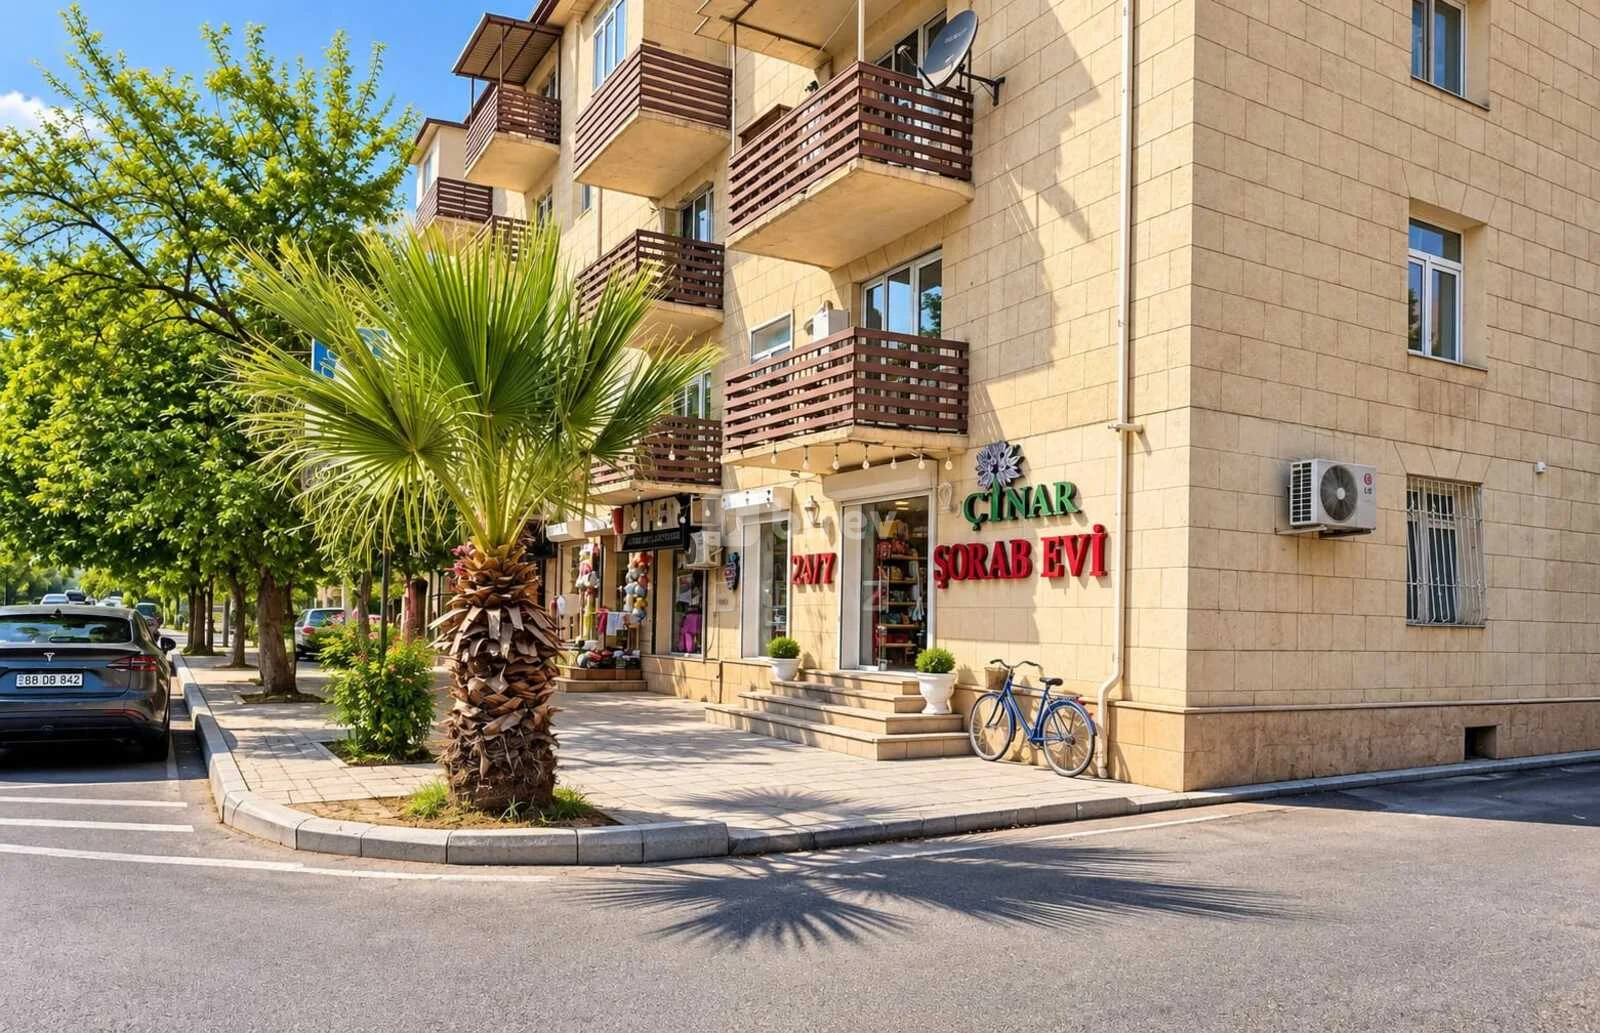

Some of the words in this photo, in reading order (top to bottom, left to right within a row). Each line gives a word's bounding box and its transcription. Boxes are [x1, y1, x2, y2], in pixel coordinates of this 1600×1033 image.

[1040, 523, 1109, 578] EVİ
[25, 675, 39, 685] 88
[60, 675, 80, 685] 842
